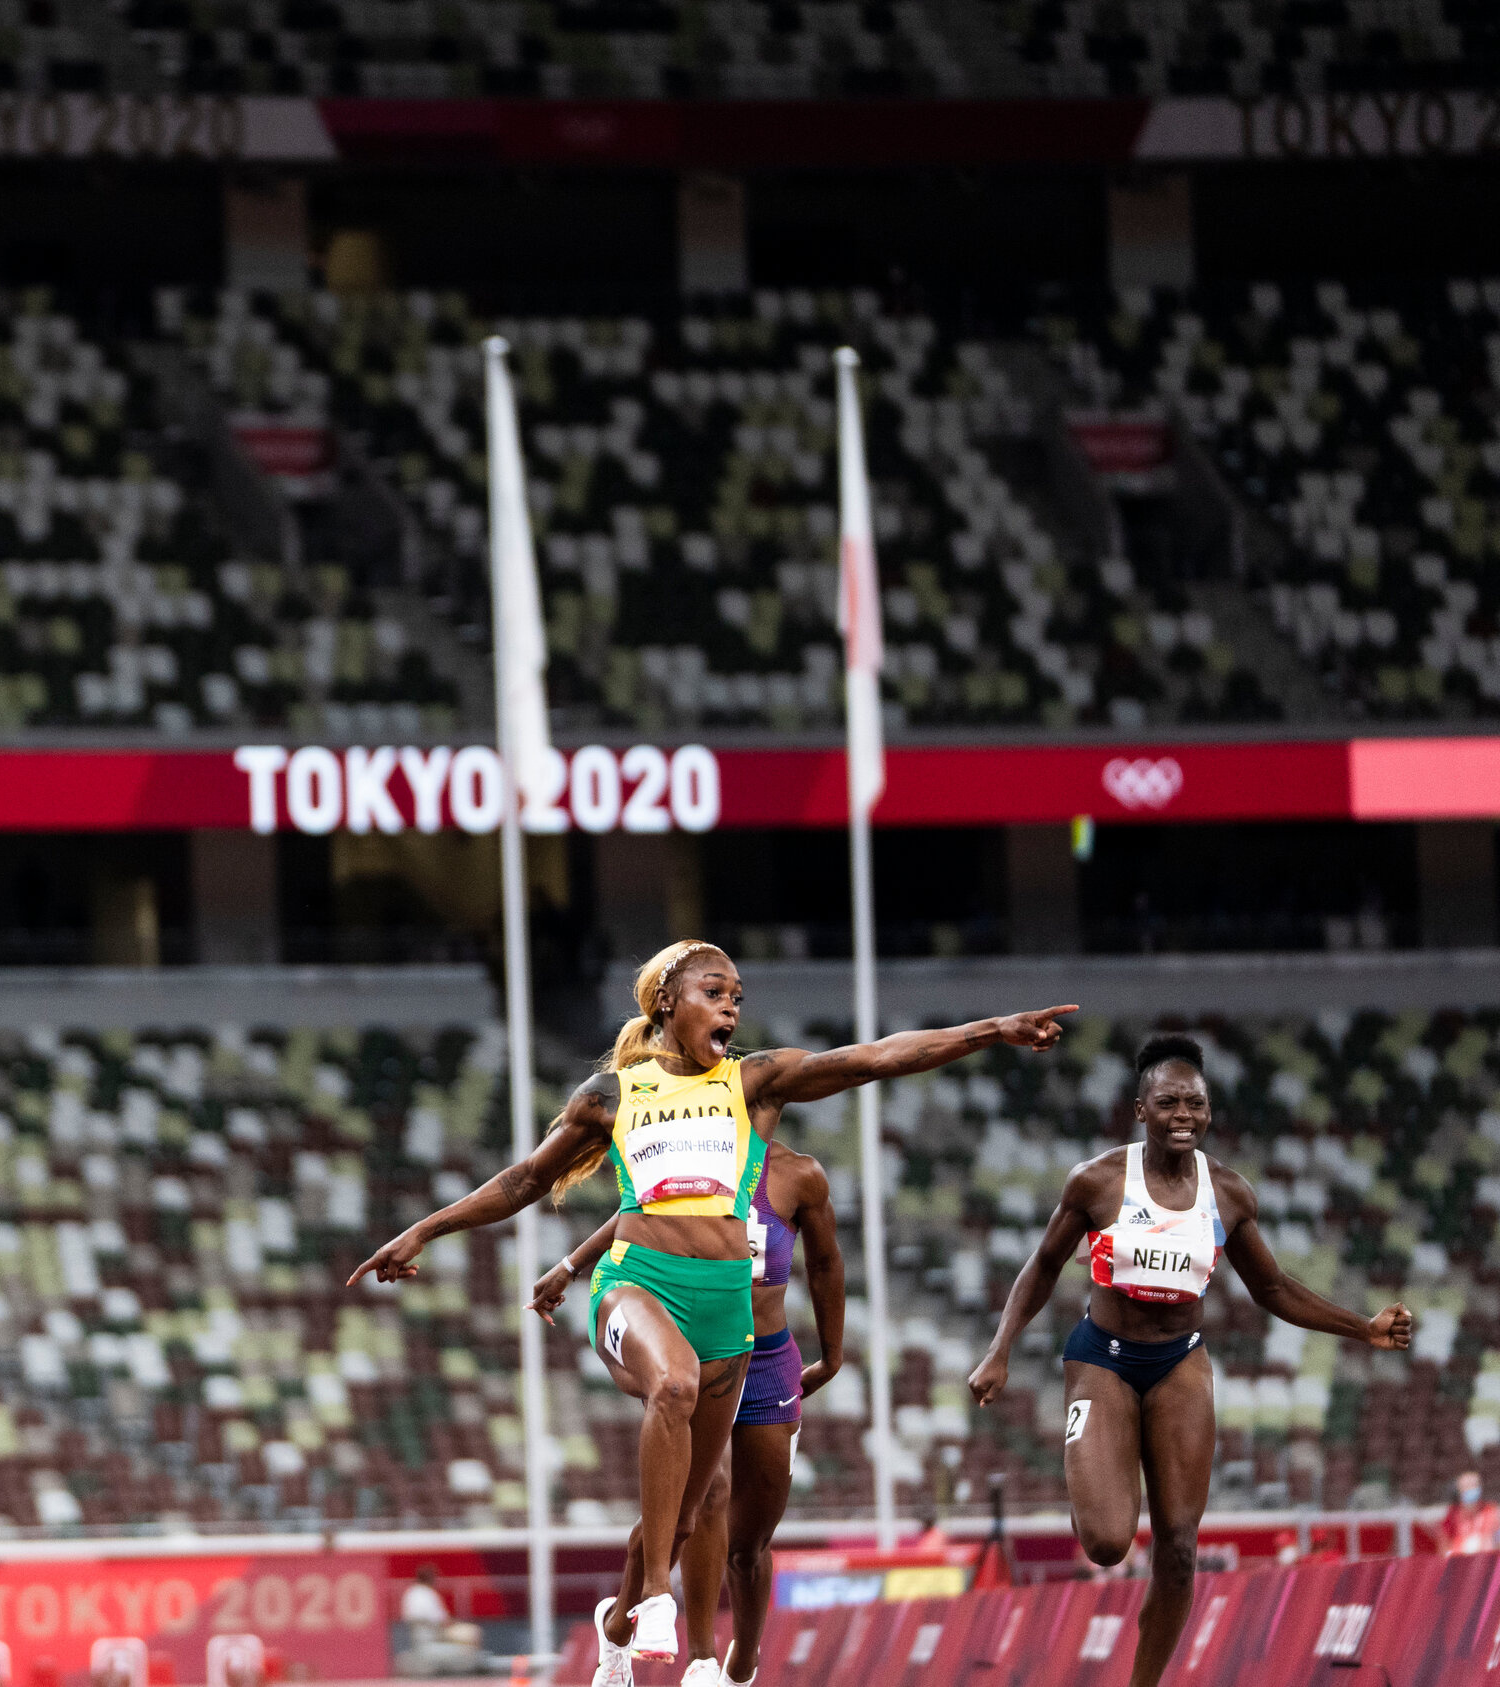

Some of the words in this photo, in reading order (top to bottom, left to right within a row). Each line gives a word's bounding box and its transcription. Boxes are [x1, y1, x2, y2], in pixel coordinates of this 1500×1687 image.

[96, 93, 242, 162] 2020
[1232, 90, 1451, 160] TOKYO
[233, 744, 504, 836] TOKYO
[521, 743, 721, 834] 2020
[679, 1182, 693, 1190] 2020
[1133, 1247, 1191, 1272] NEITA
[1137, 1289, 1153, 1298] TOKYO
[608, 1323, 620, 1352] 4
[1067, 1406, 1081, 1439] 2
[210, 1573, 377, 1632] 2020
